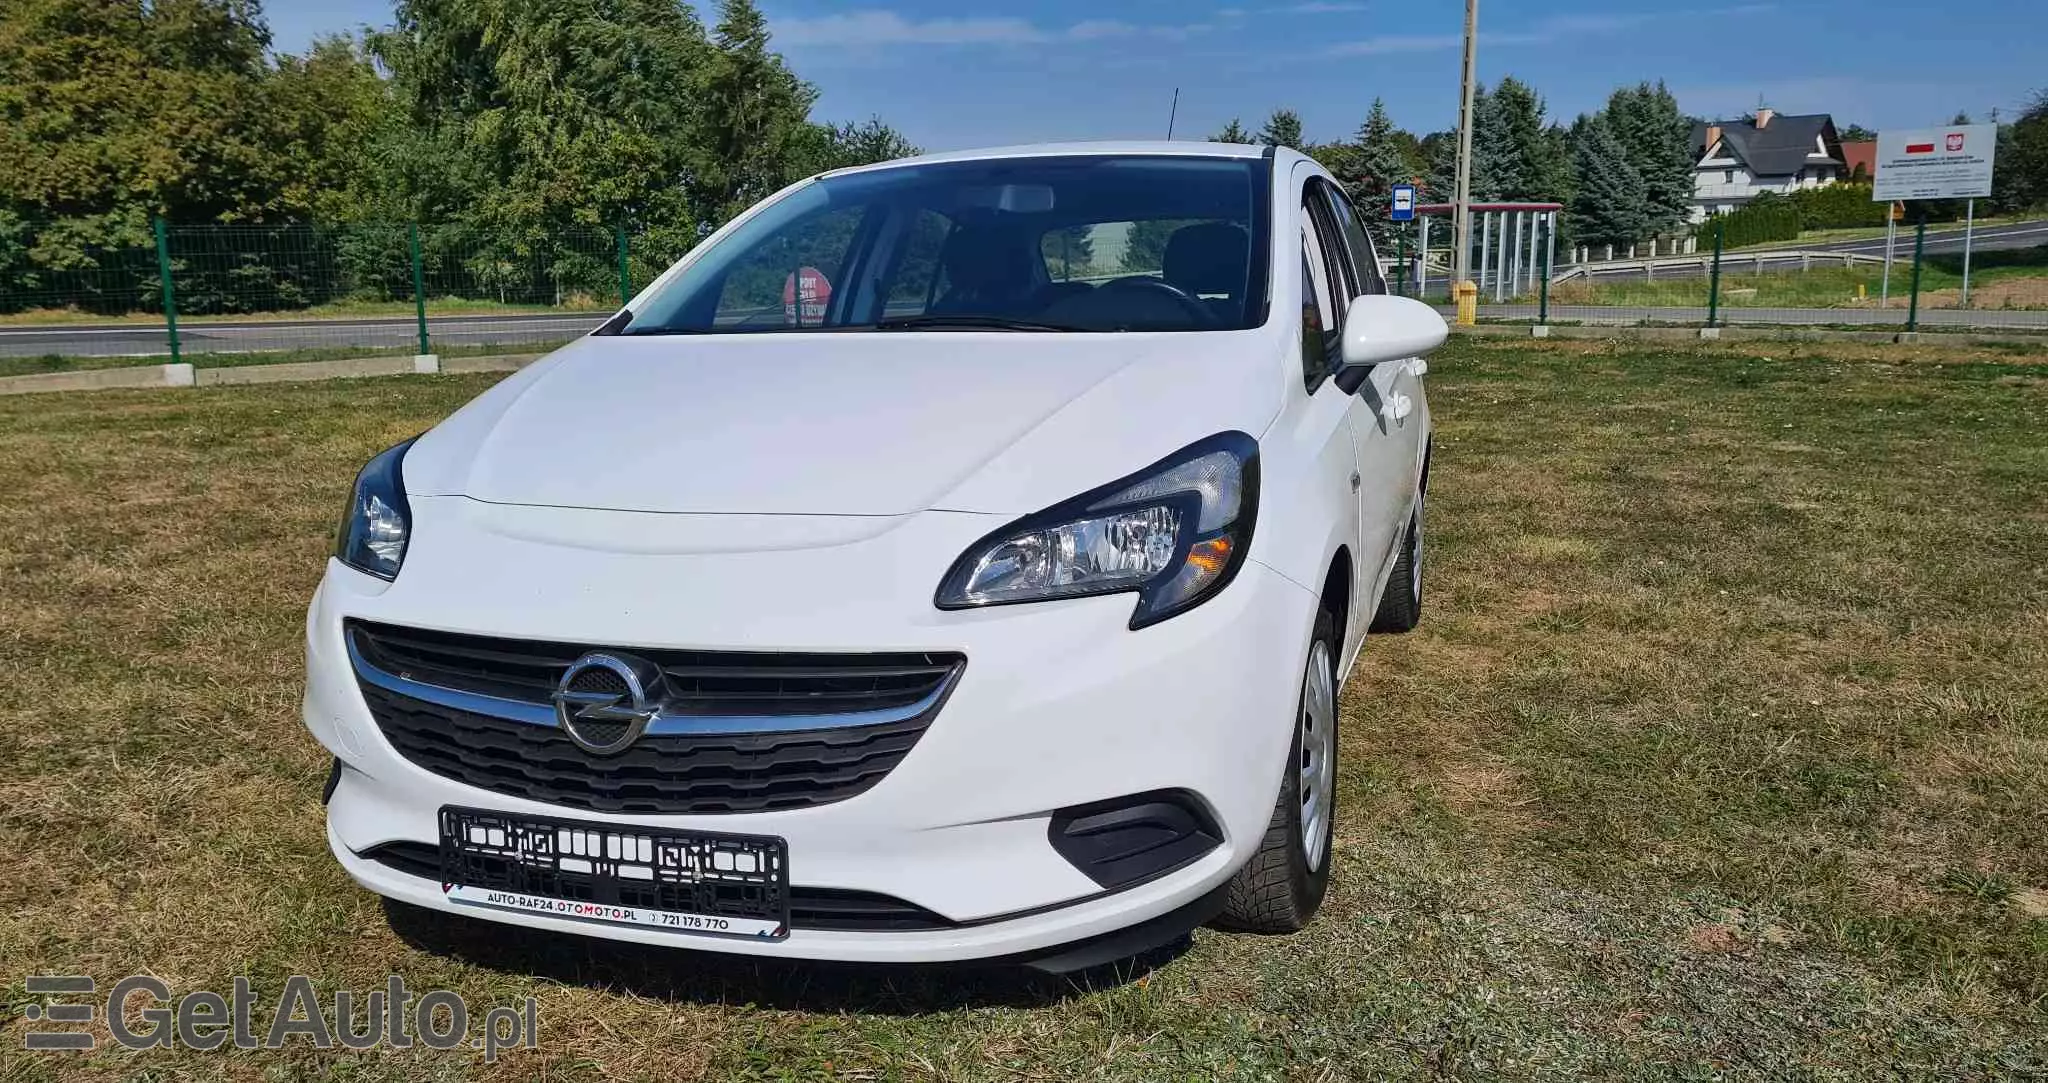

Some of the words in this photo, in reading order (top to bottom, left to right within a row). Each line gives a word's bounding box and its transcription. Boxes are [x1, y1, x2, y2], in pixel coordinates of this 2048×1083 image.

[661, 913, 680, 926] 721
[683, 916, 701, 928] 178
[705, 918, 729, 930] 770
